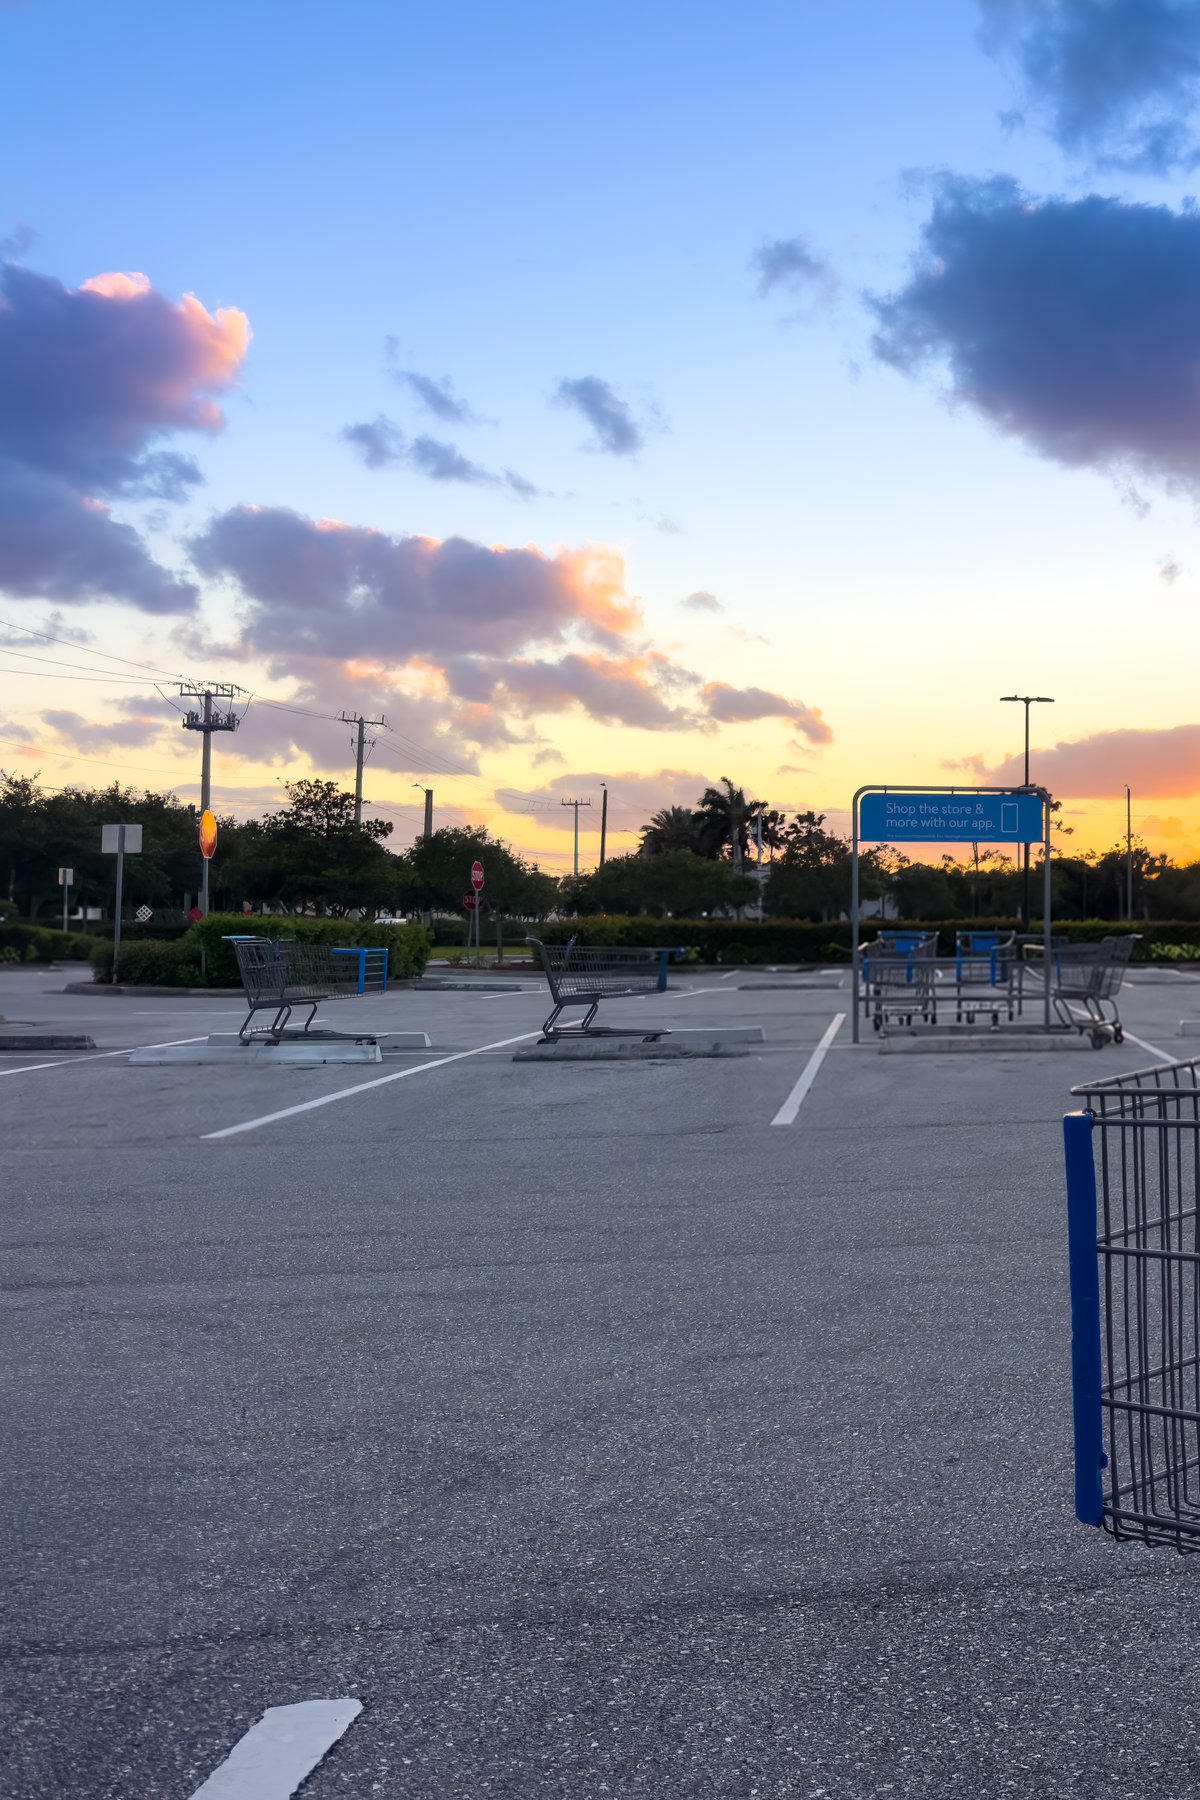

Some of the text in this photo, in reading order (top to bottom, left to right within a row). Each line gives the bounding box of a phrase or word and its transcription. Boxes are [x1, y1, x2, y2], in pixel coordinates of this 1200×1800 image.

[886, 802, 984, 817] Shop the store &
[886, 817, 996, 831] more with our app.
